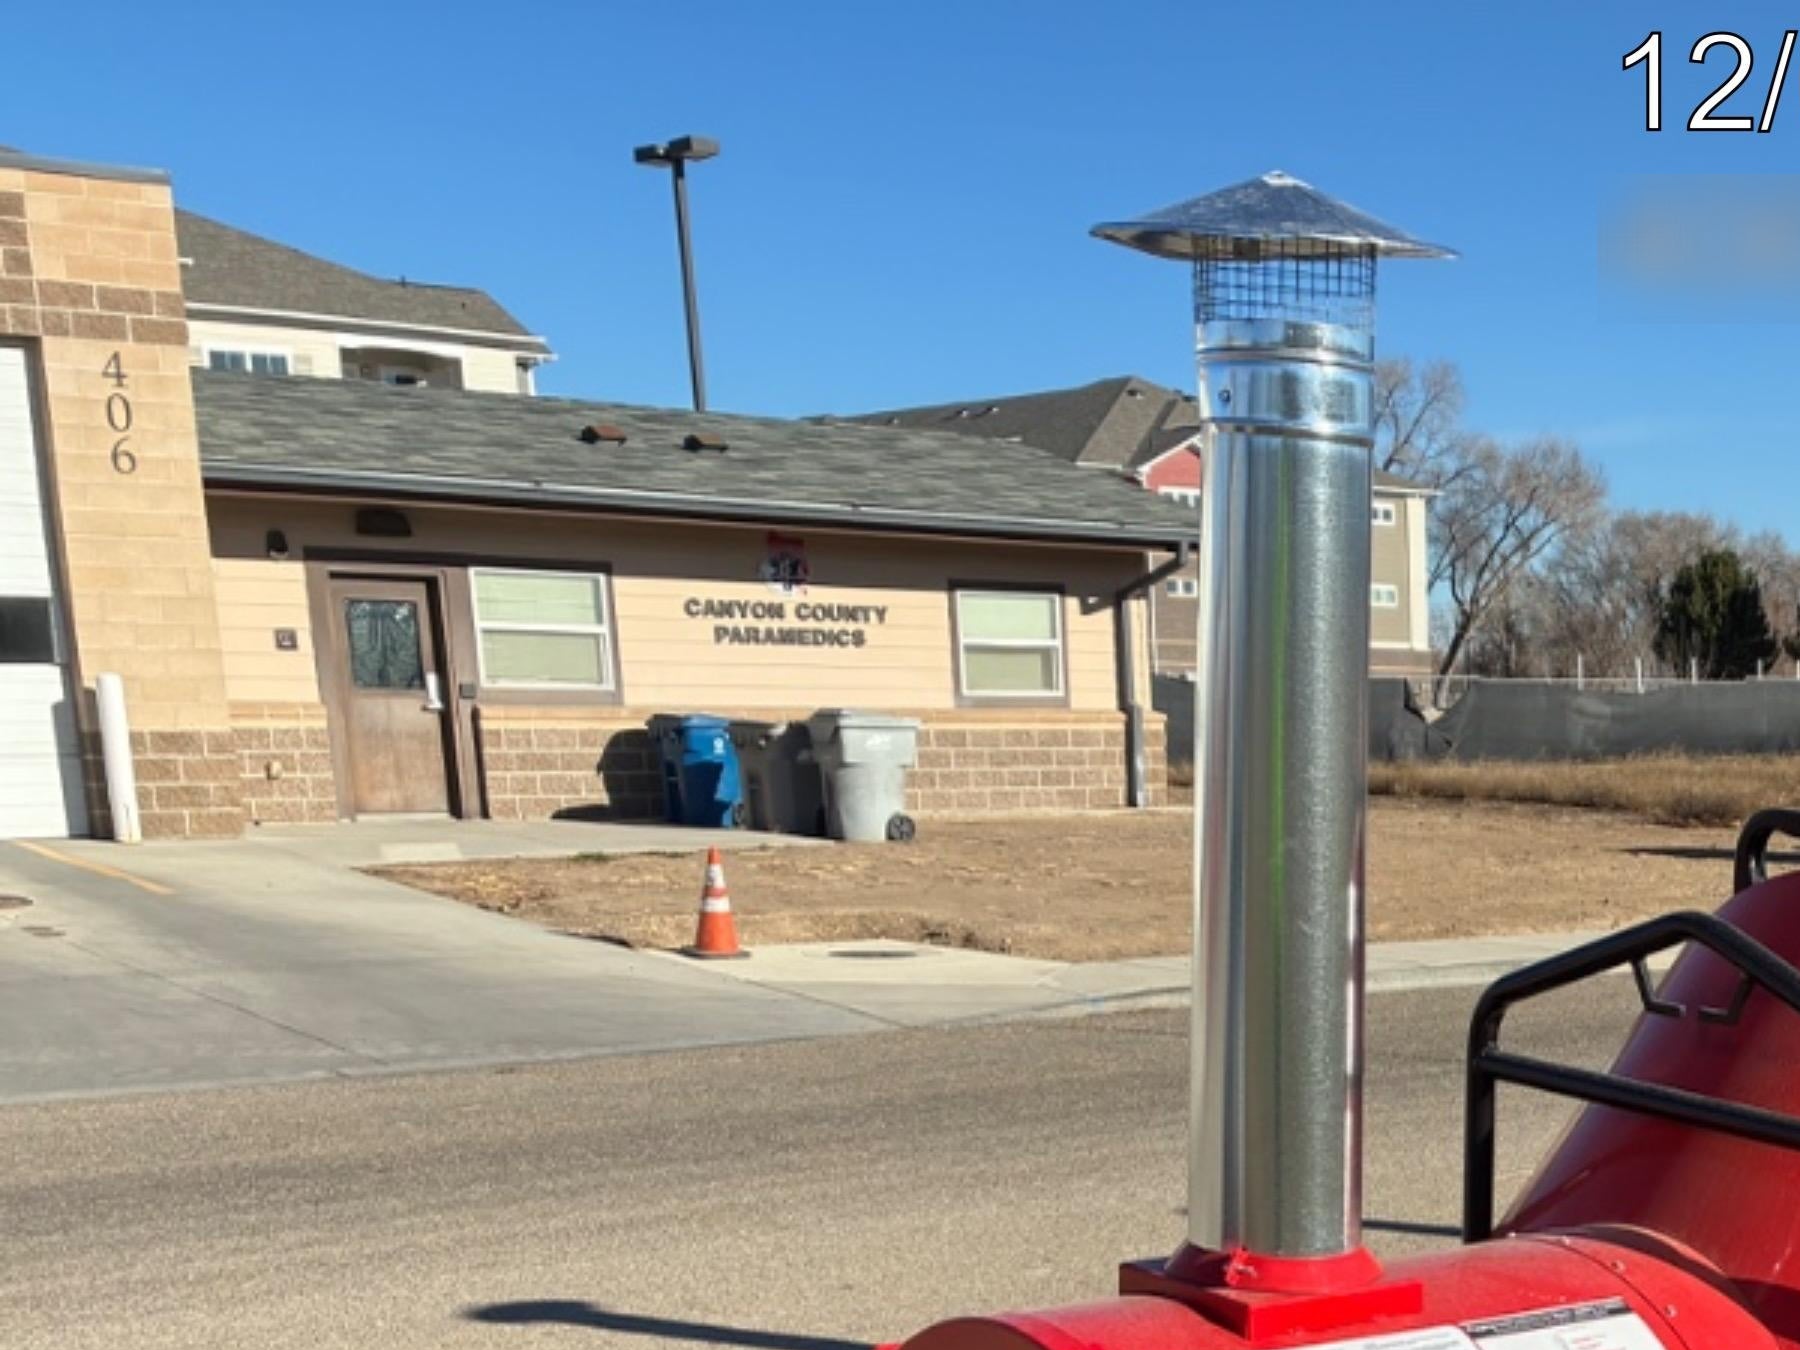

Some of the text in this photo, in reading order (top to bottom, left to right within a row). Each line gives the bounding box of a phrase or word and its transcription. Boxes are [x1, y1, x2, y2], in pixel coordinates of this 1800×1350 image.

[101, 350, 136, 474] 406
[683, 597, 887, 624] CANYON COUNTY
[713, 625, 865, 647] PARAMEDICS
